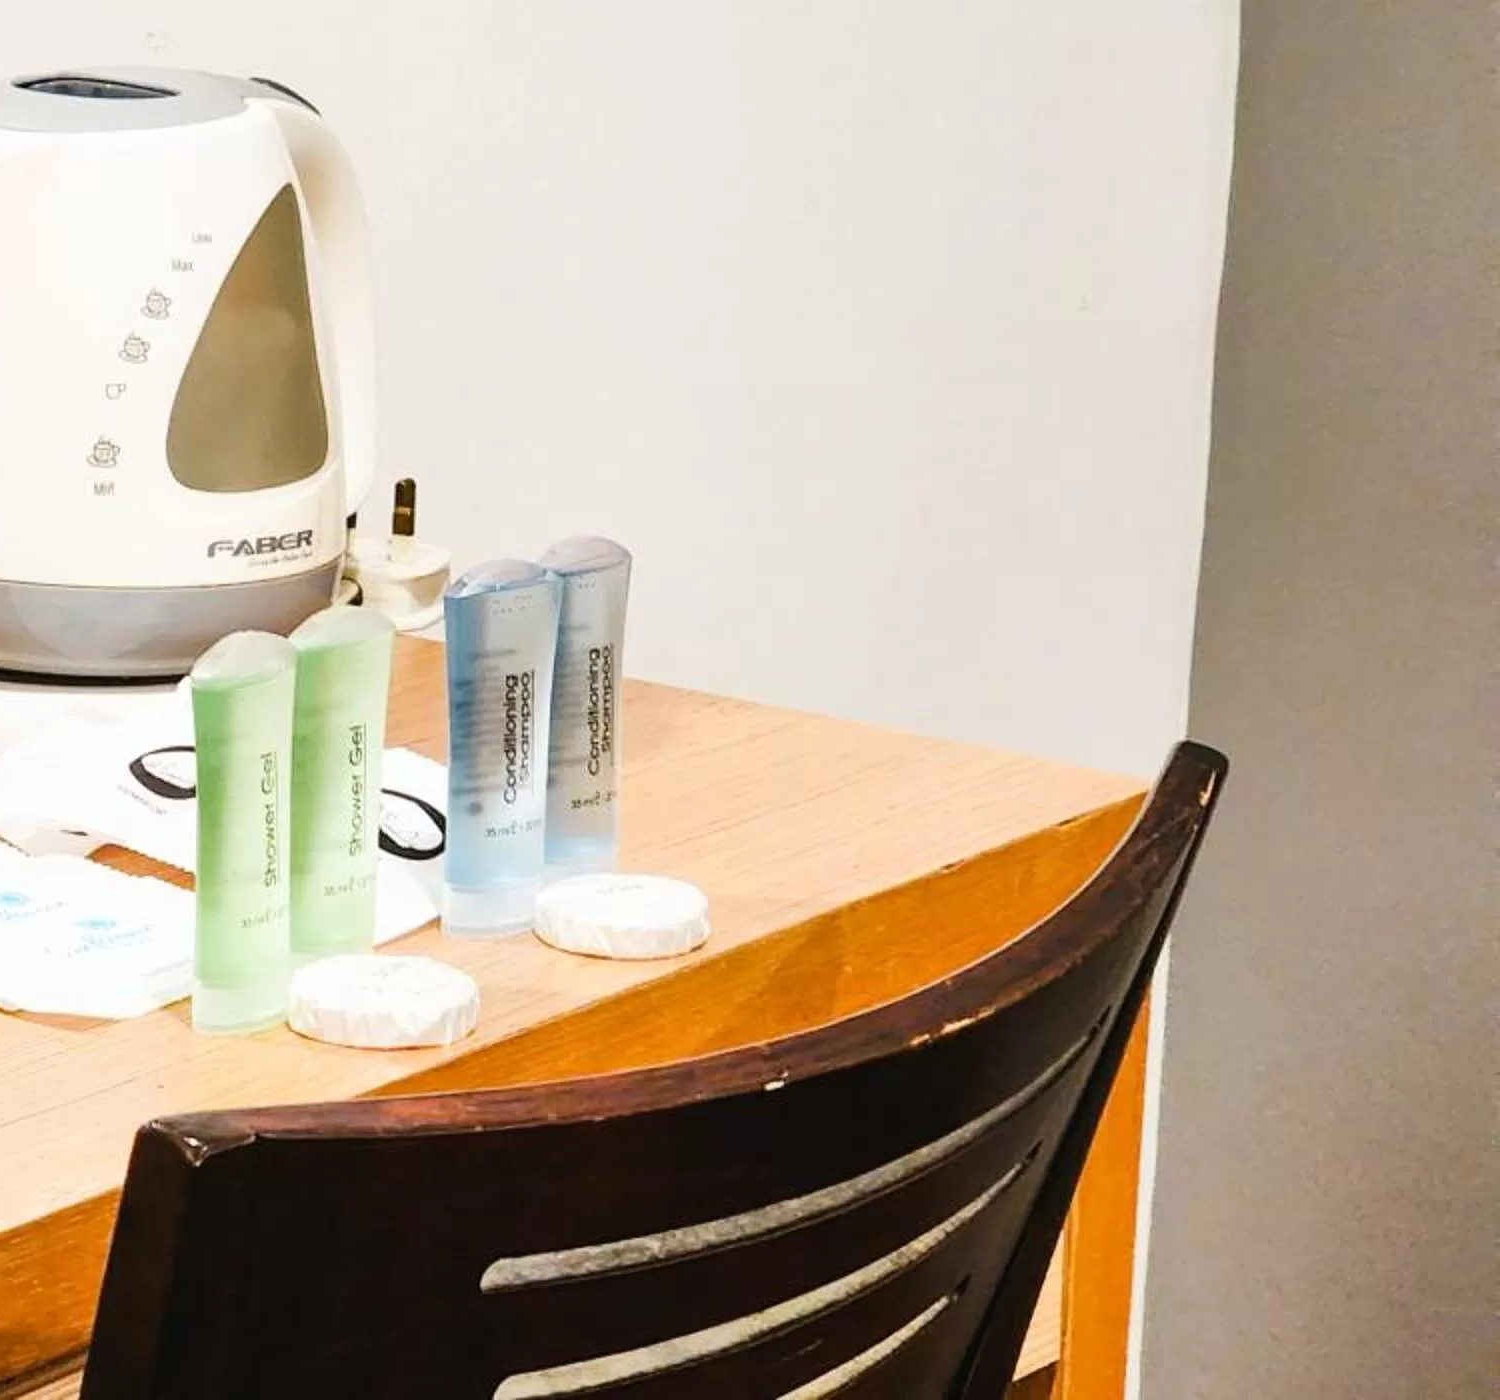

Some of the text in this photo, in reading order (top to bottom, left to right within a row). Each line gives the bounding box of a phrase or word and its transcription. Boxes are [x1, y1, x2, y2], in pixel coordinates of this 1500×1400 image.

[207, 529, 313, 558] FABER
[503, 673, 518, 804] Conditioning
[520, 671, 531, 783] Shampoo
[588, 647, 601, 777] Conditioning
[602, 645, 613, 753] Shampoo
[260, 752, 277, 887] Shower Gel
[348, 724, 363, 857] Shower Gel
